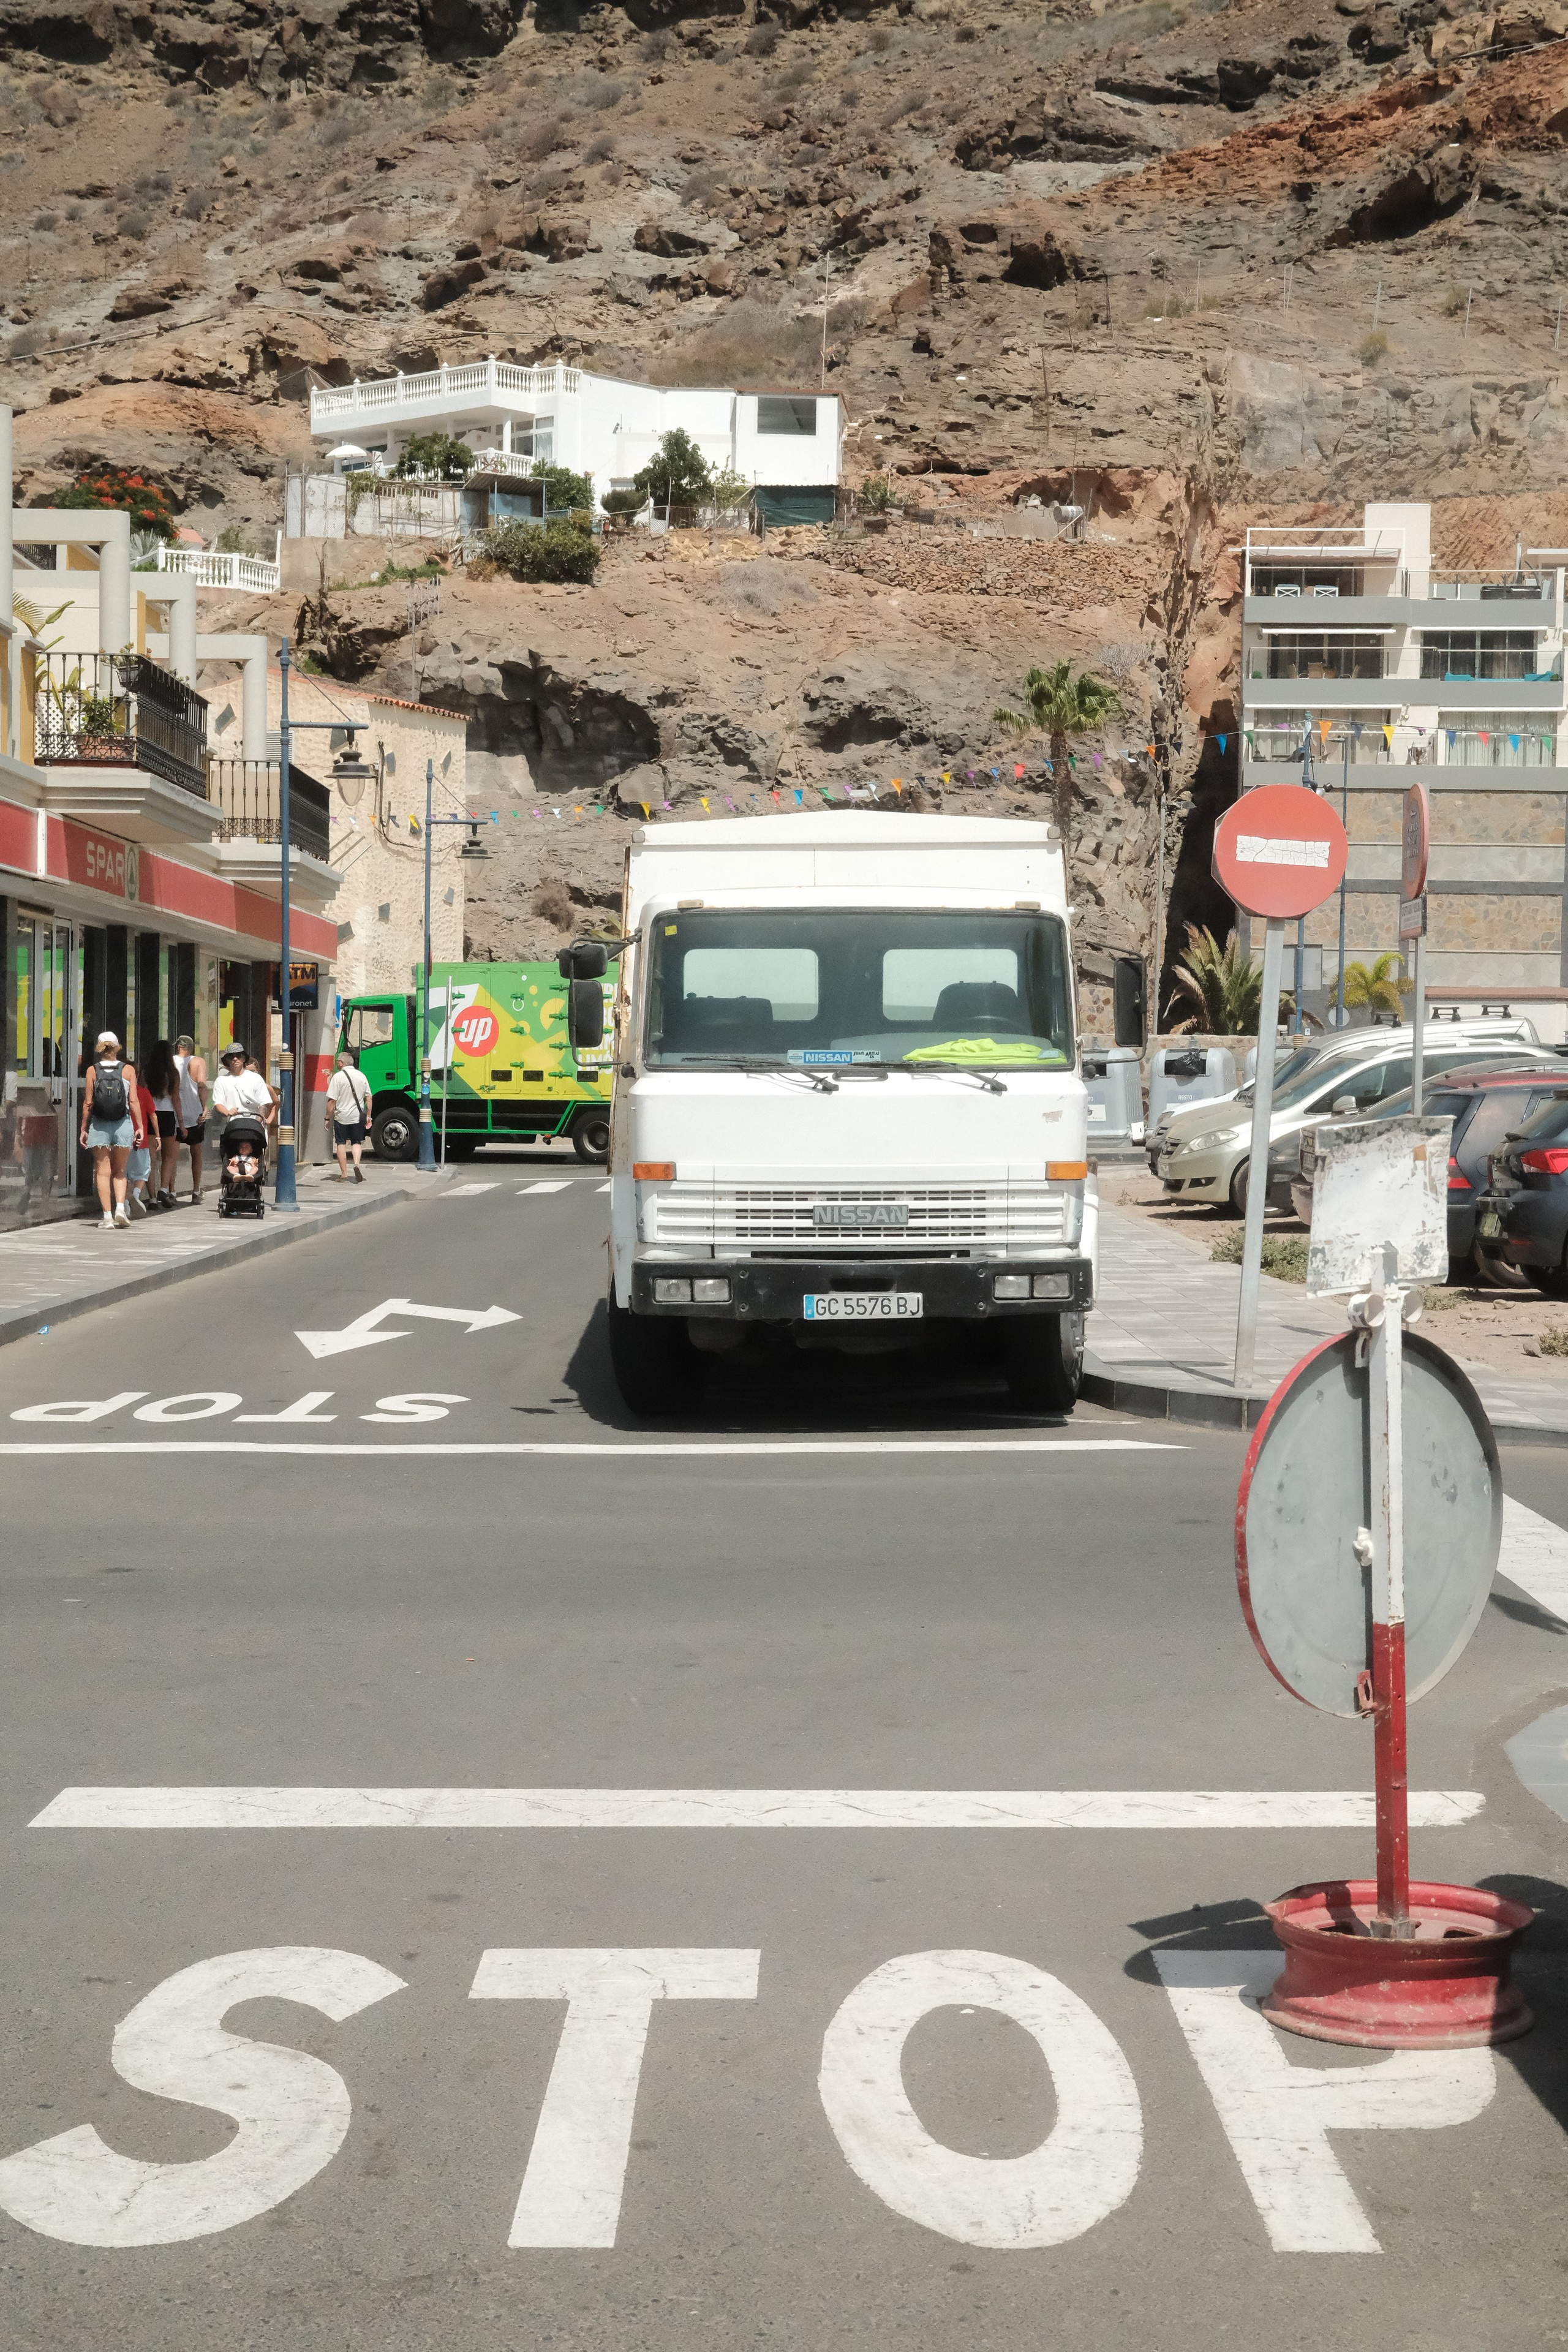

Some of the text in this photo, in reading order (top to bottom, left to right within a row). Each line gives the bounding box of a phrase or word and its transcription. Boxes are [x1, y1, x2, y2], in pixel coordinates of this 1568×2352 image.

[86, 840, 124, 888] SPAR
[578, 1050, 614, 1074] LIMÓ
[805, 1053, 850, 1062] NISSAN
[814, 1206, 907, 1223] NISSAN
[816, 1298, 839, 1316] GC
[843, 1296, 892, 1315] 5576
[897, 1297, 920, 1315] BJ
[9, 1392, 470, 1423] STOP
[0, 1946, 1498, 2254] STOP
